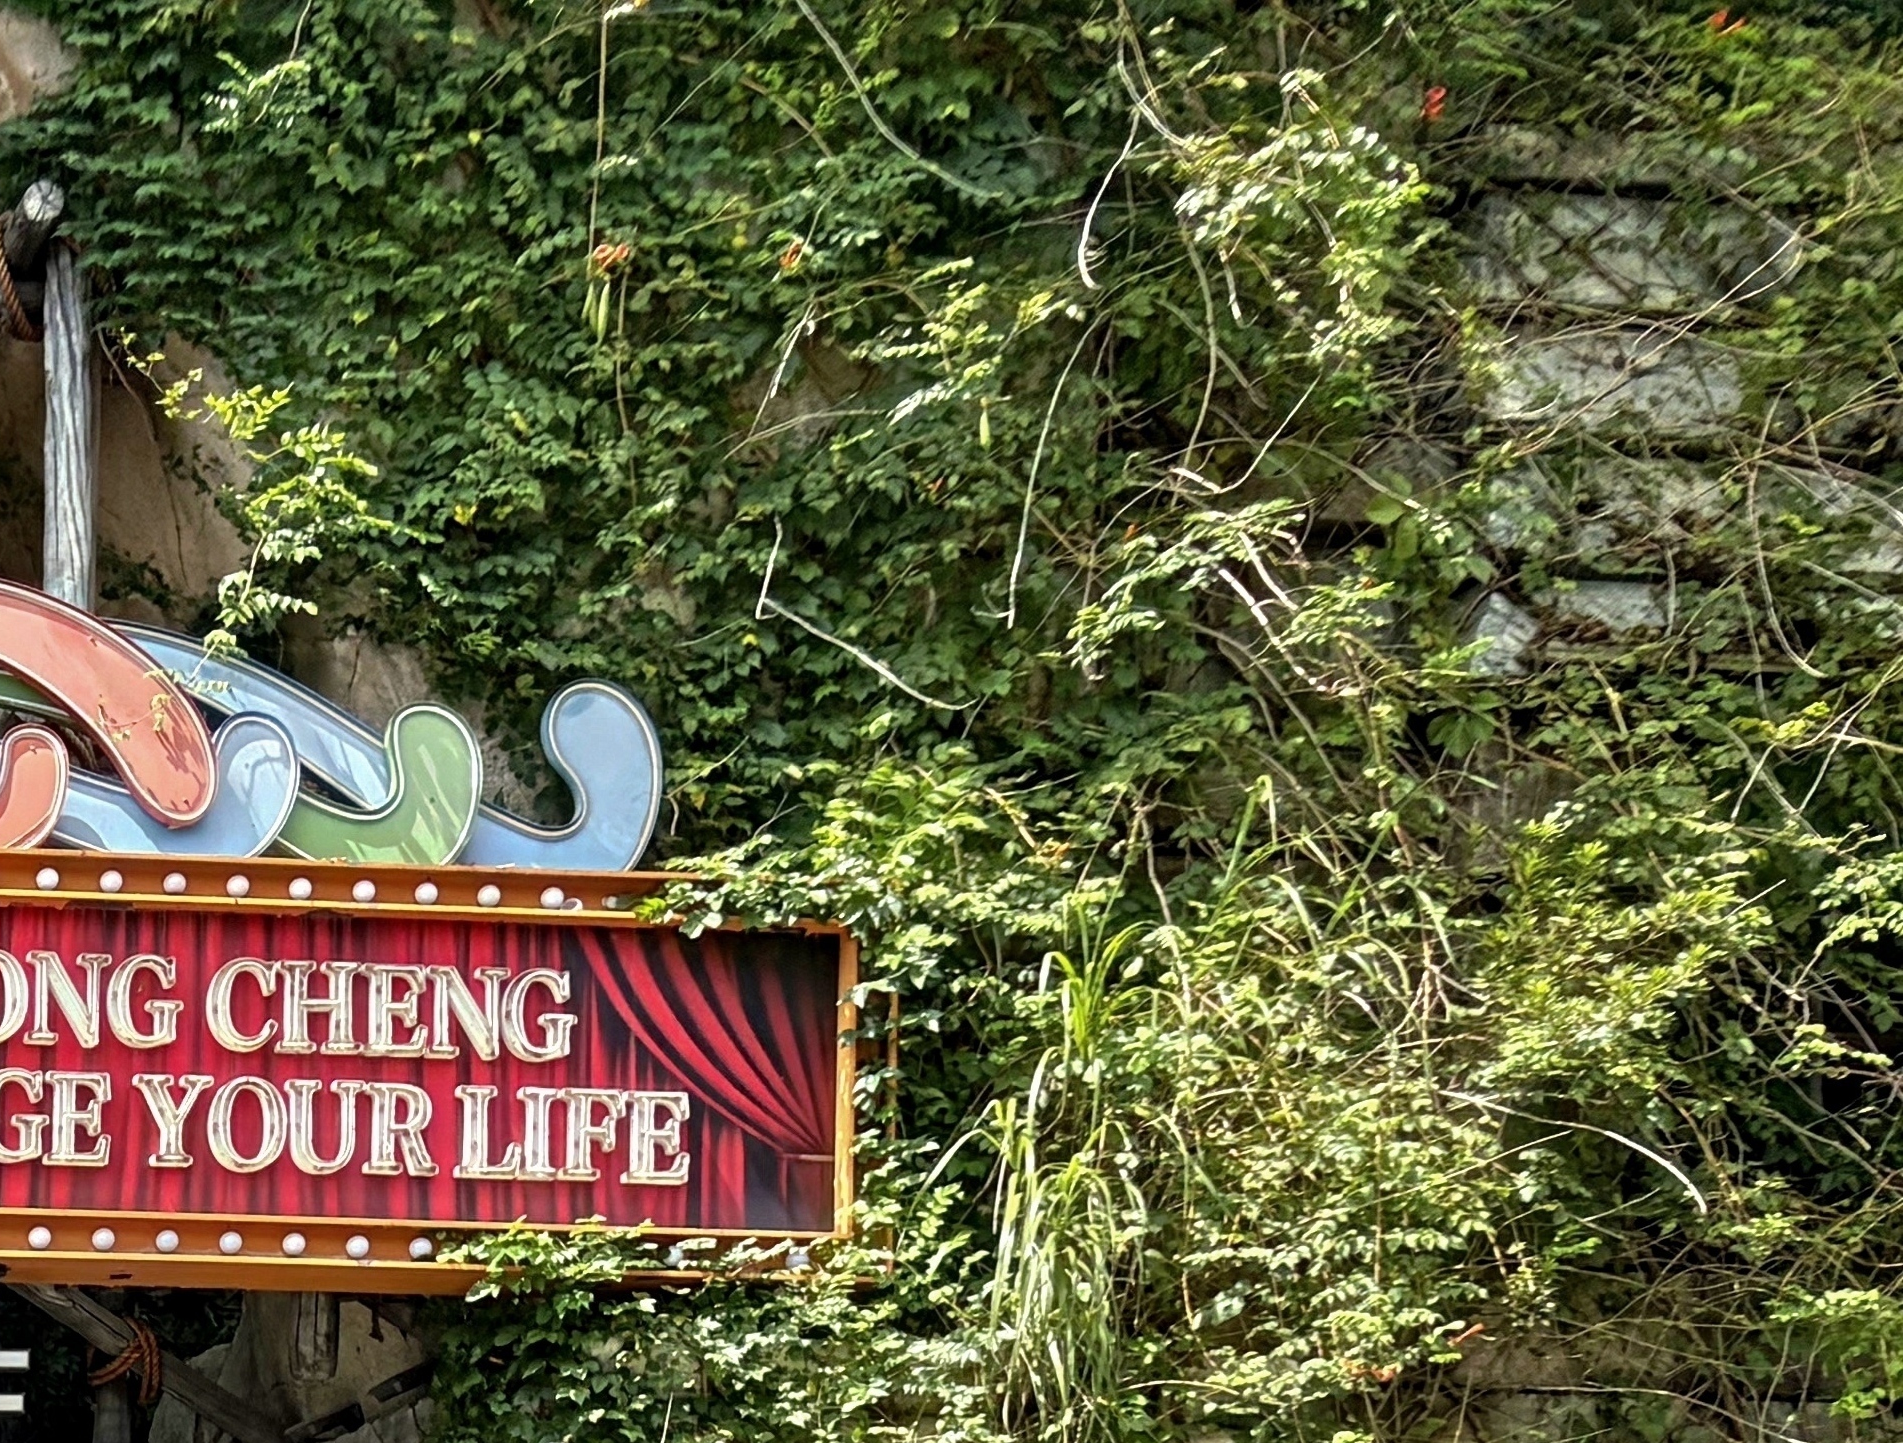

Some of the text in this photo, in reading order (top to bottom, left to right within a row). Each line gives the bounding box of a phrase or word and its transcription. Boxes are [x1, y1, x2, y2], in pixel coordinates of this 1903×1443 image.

[205, 954, 579, 1064] CHENG
[131, 1069, 439, 1179] YOUR
[454, 1083, 692, 1187] LIFE
